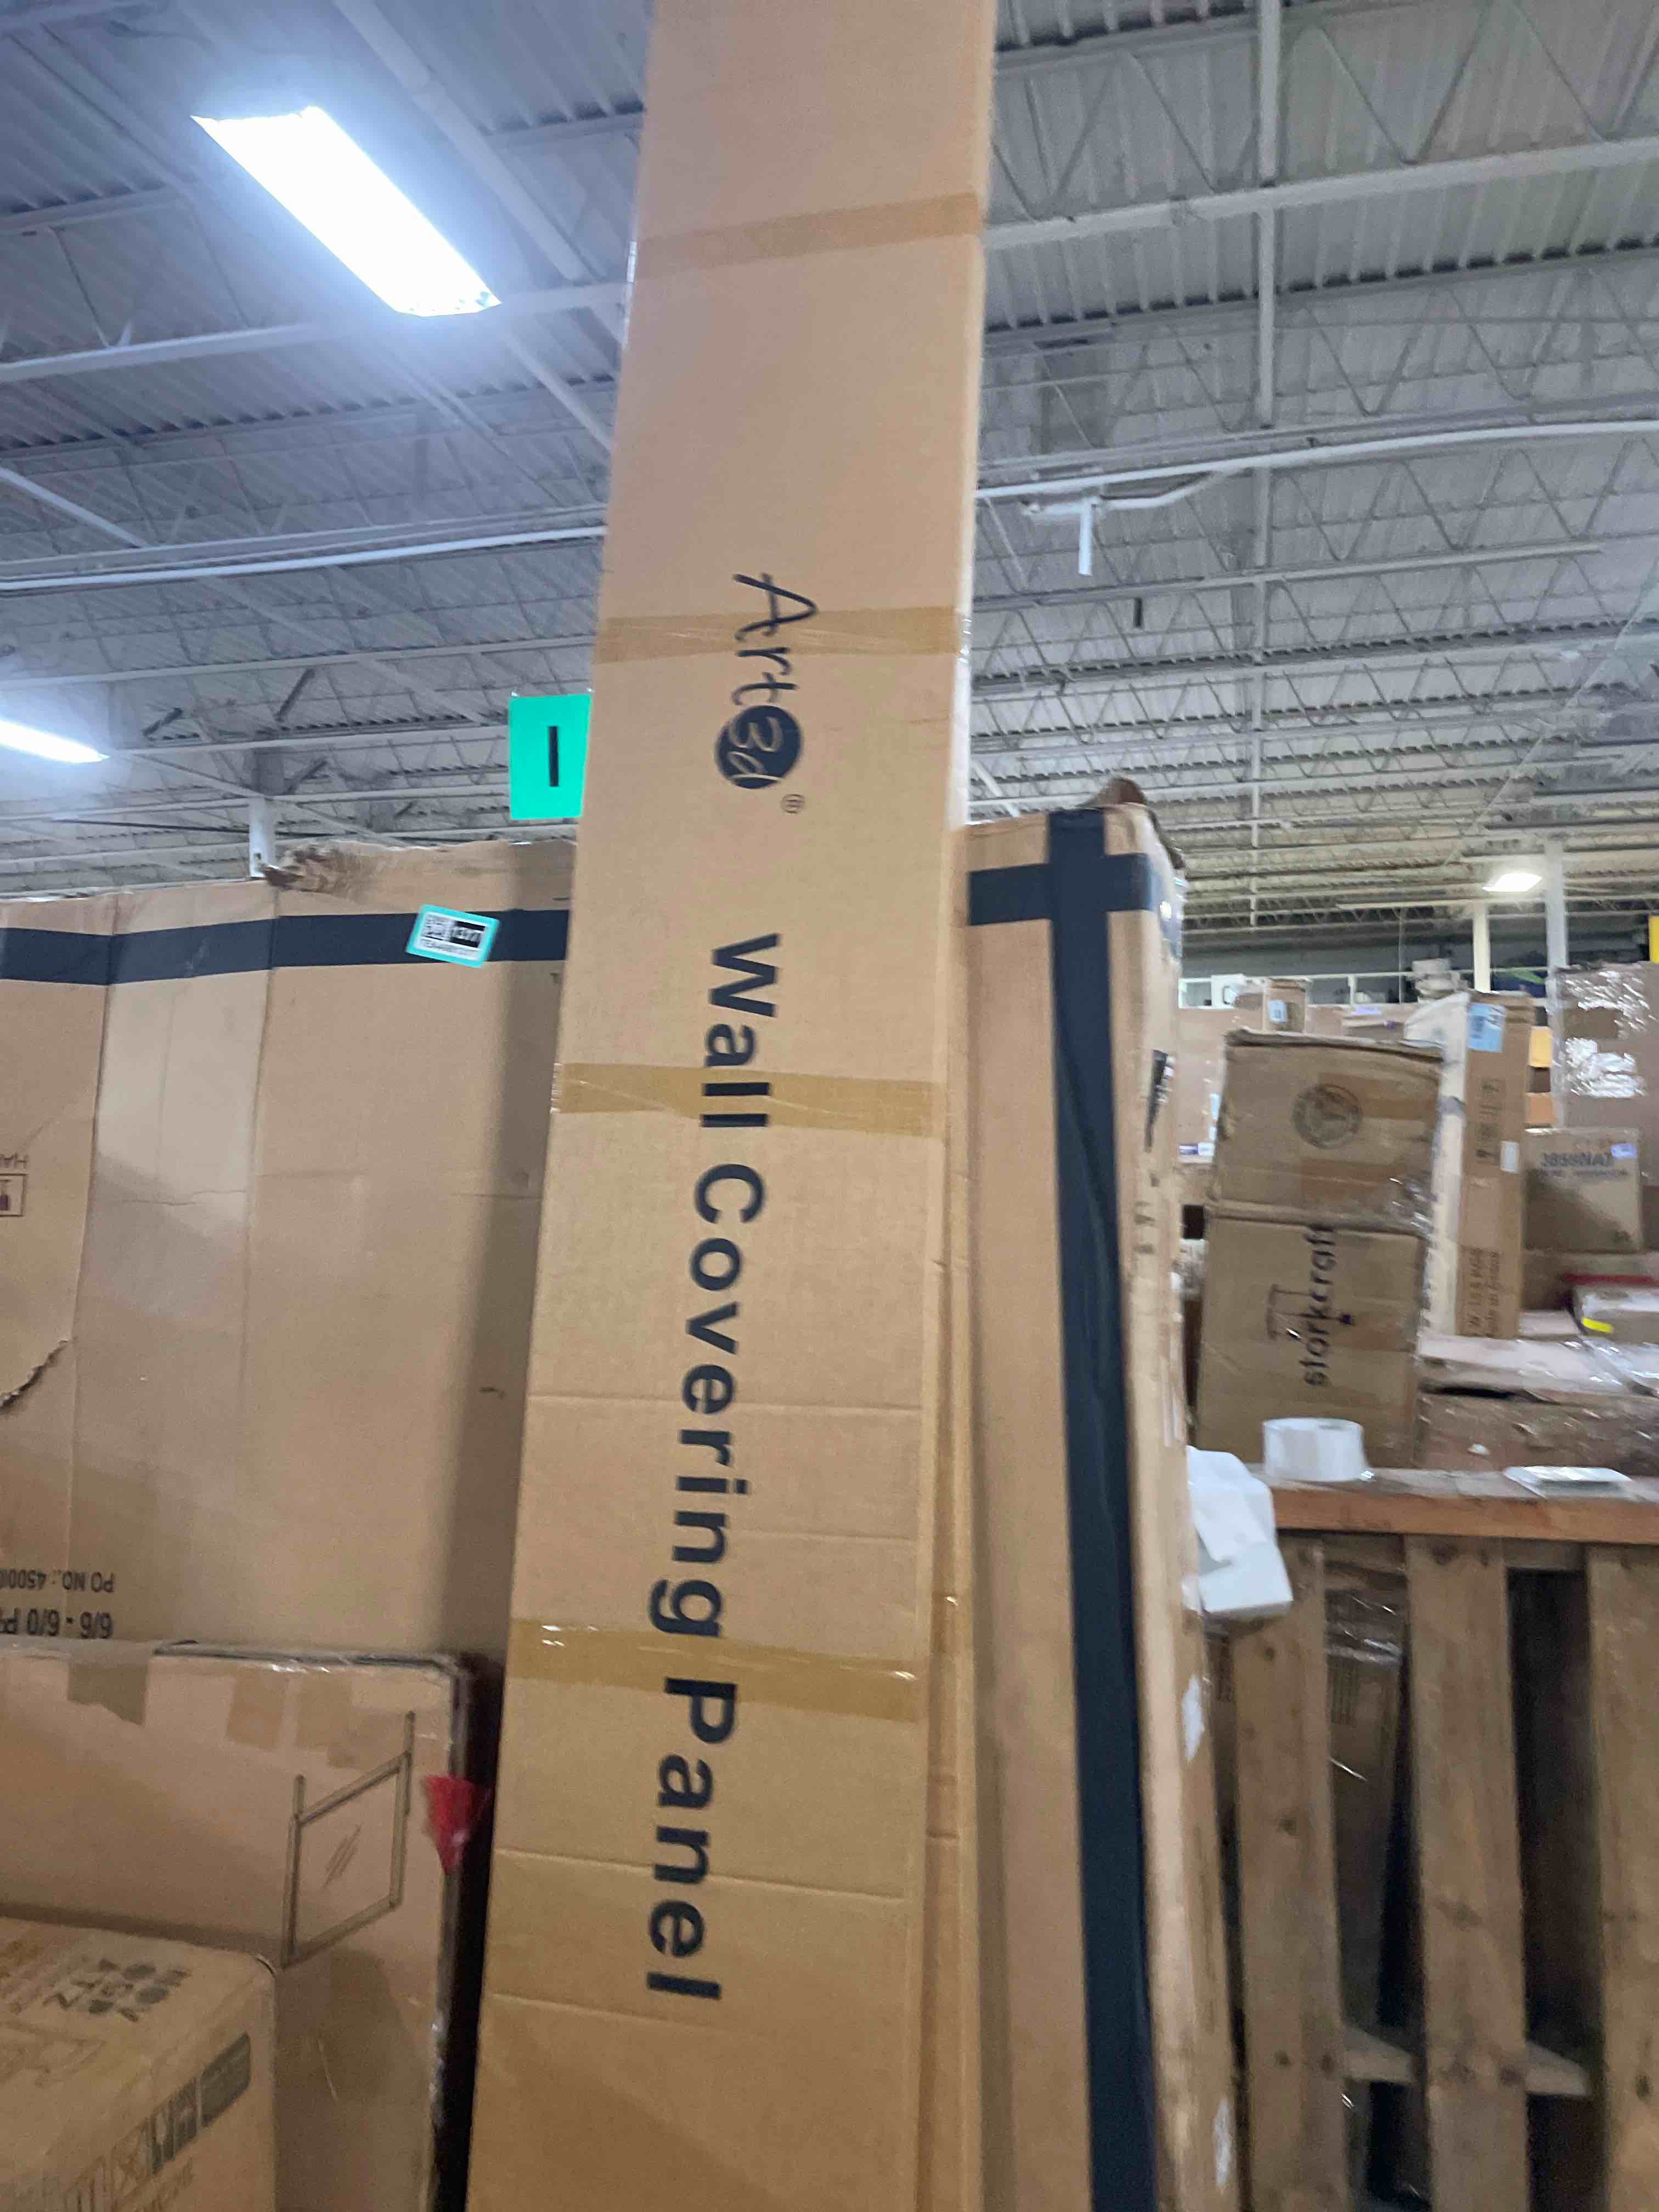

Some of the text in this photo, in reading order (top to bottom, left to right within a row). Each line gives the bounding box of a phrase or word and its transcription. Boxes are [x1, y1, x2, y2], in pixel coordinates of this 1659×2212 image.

[91, 1572, 115, 1593] PO
[646, 933, 781, 2001] Wall Covering Panel
